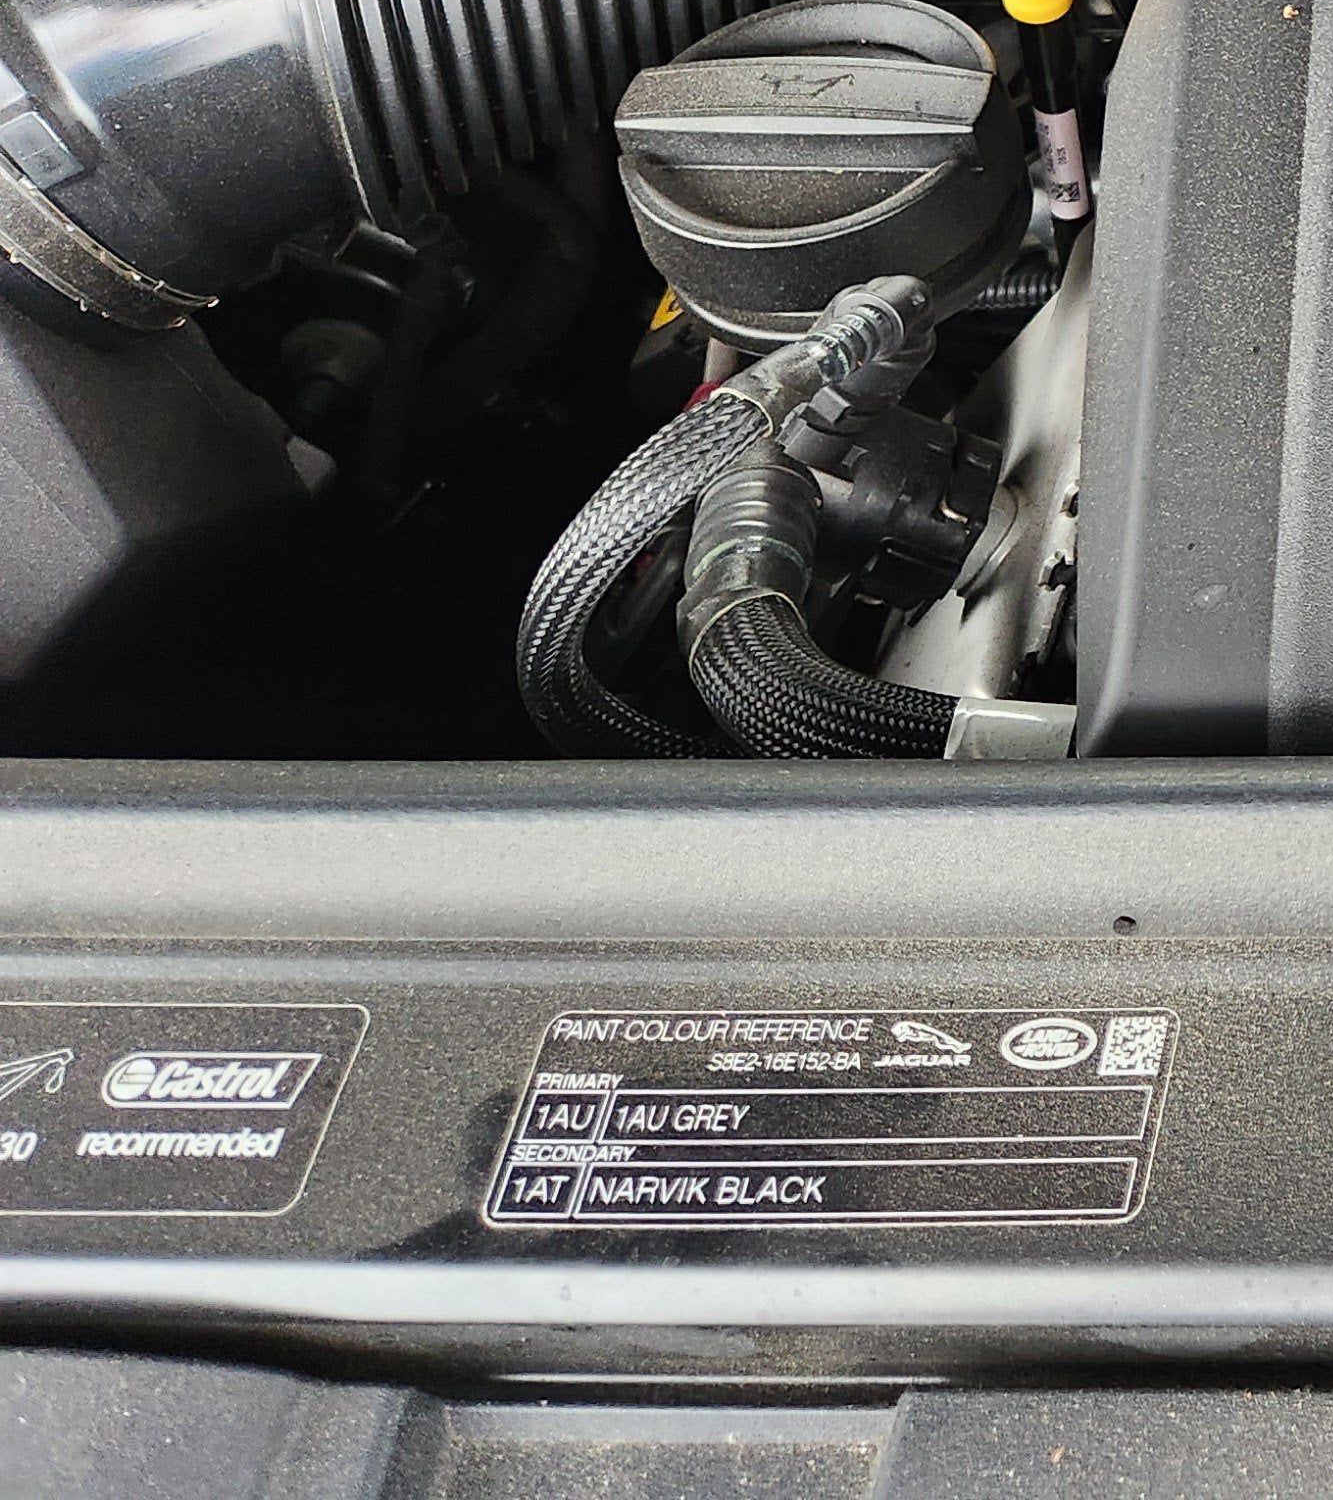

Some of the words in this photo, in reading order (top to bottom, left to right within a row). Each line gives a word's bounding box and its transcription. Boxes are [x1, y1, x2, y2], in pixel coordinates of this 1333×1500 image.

[553, 1019, 625, 1042] PAINT
[624, 1019, 730, 1042] COLOUR
[733, 1018, 874, 1042] REFERENCE
[706, 1052, 862, 1071] S8E2-16E152-BA
[873, 1054, 972, 1068] JAGUAR
[148, 1059, 293, 1099] Castrol
[536, 1073, 624, 1089] PRIMARY
[538, 1104, 596, 1132] 1AU
[616, 1104, 669, 1132] 1AU
[672, 1104, 750, 1132] GREY
[75, 1127, 286, 1157] recommended
[510, 1145, 637, 1162] SECONDARY
[511, 1175, 570, 1204] 1AT
[588, 1175, 711, 1204] NARVIK
[714, 1175, 827, 1204] BLACK
